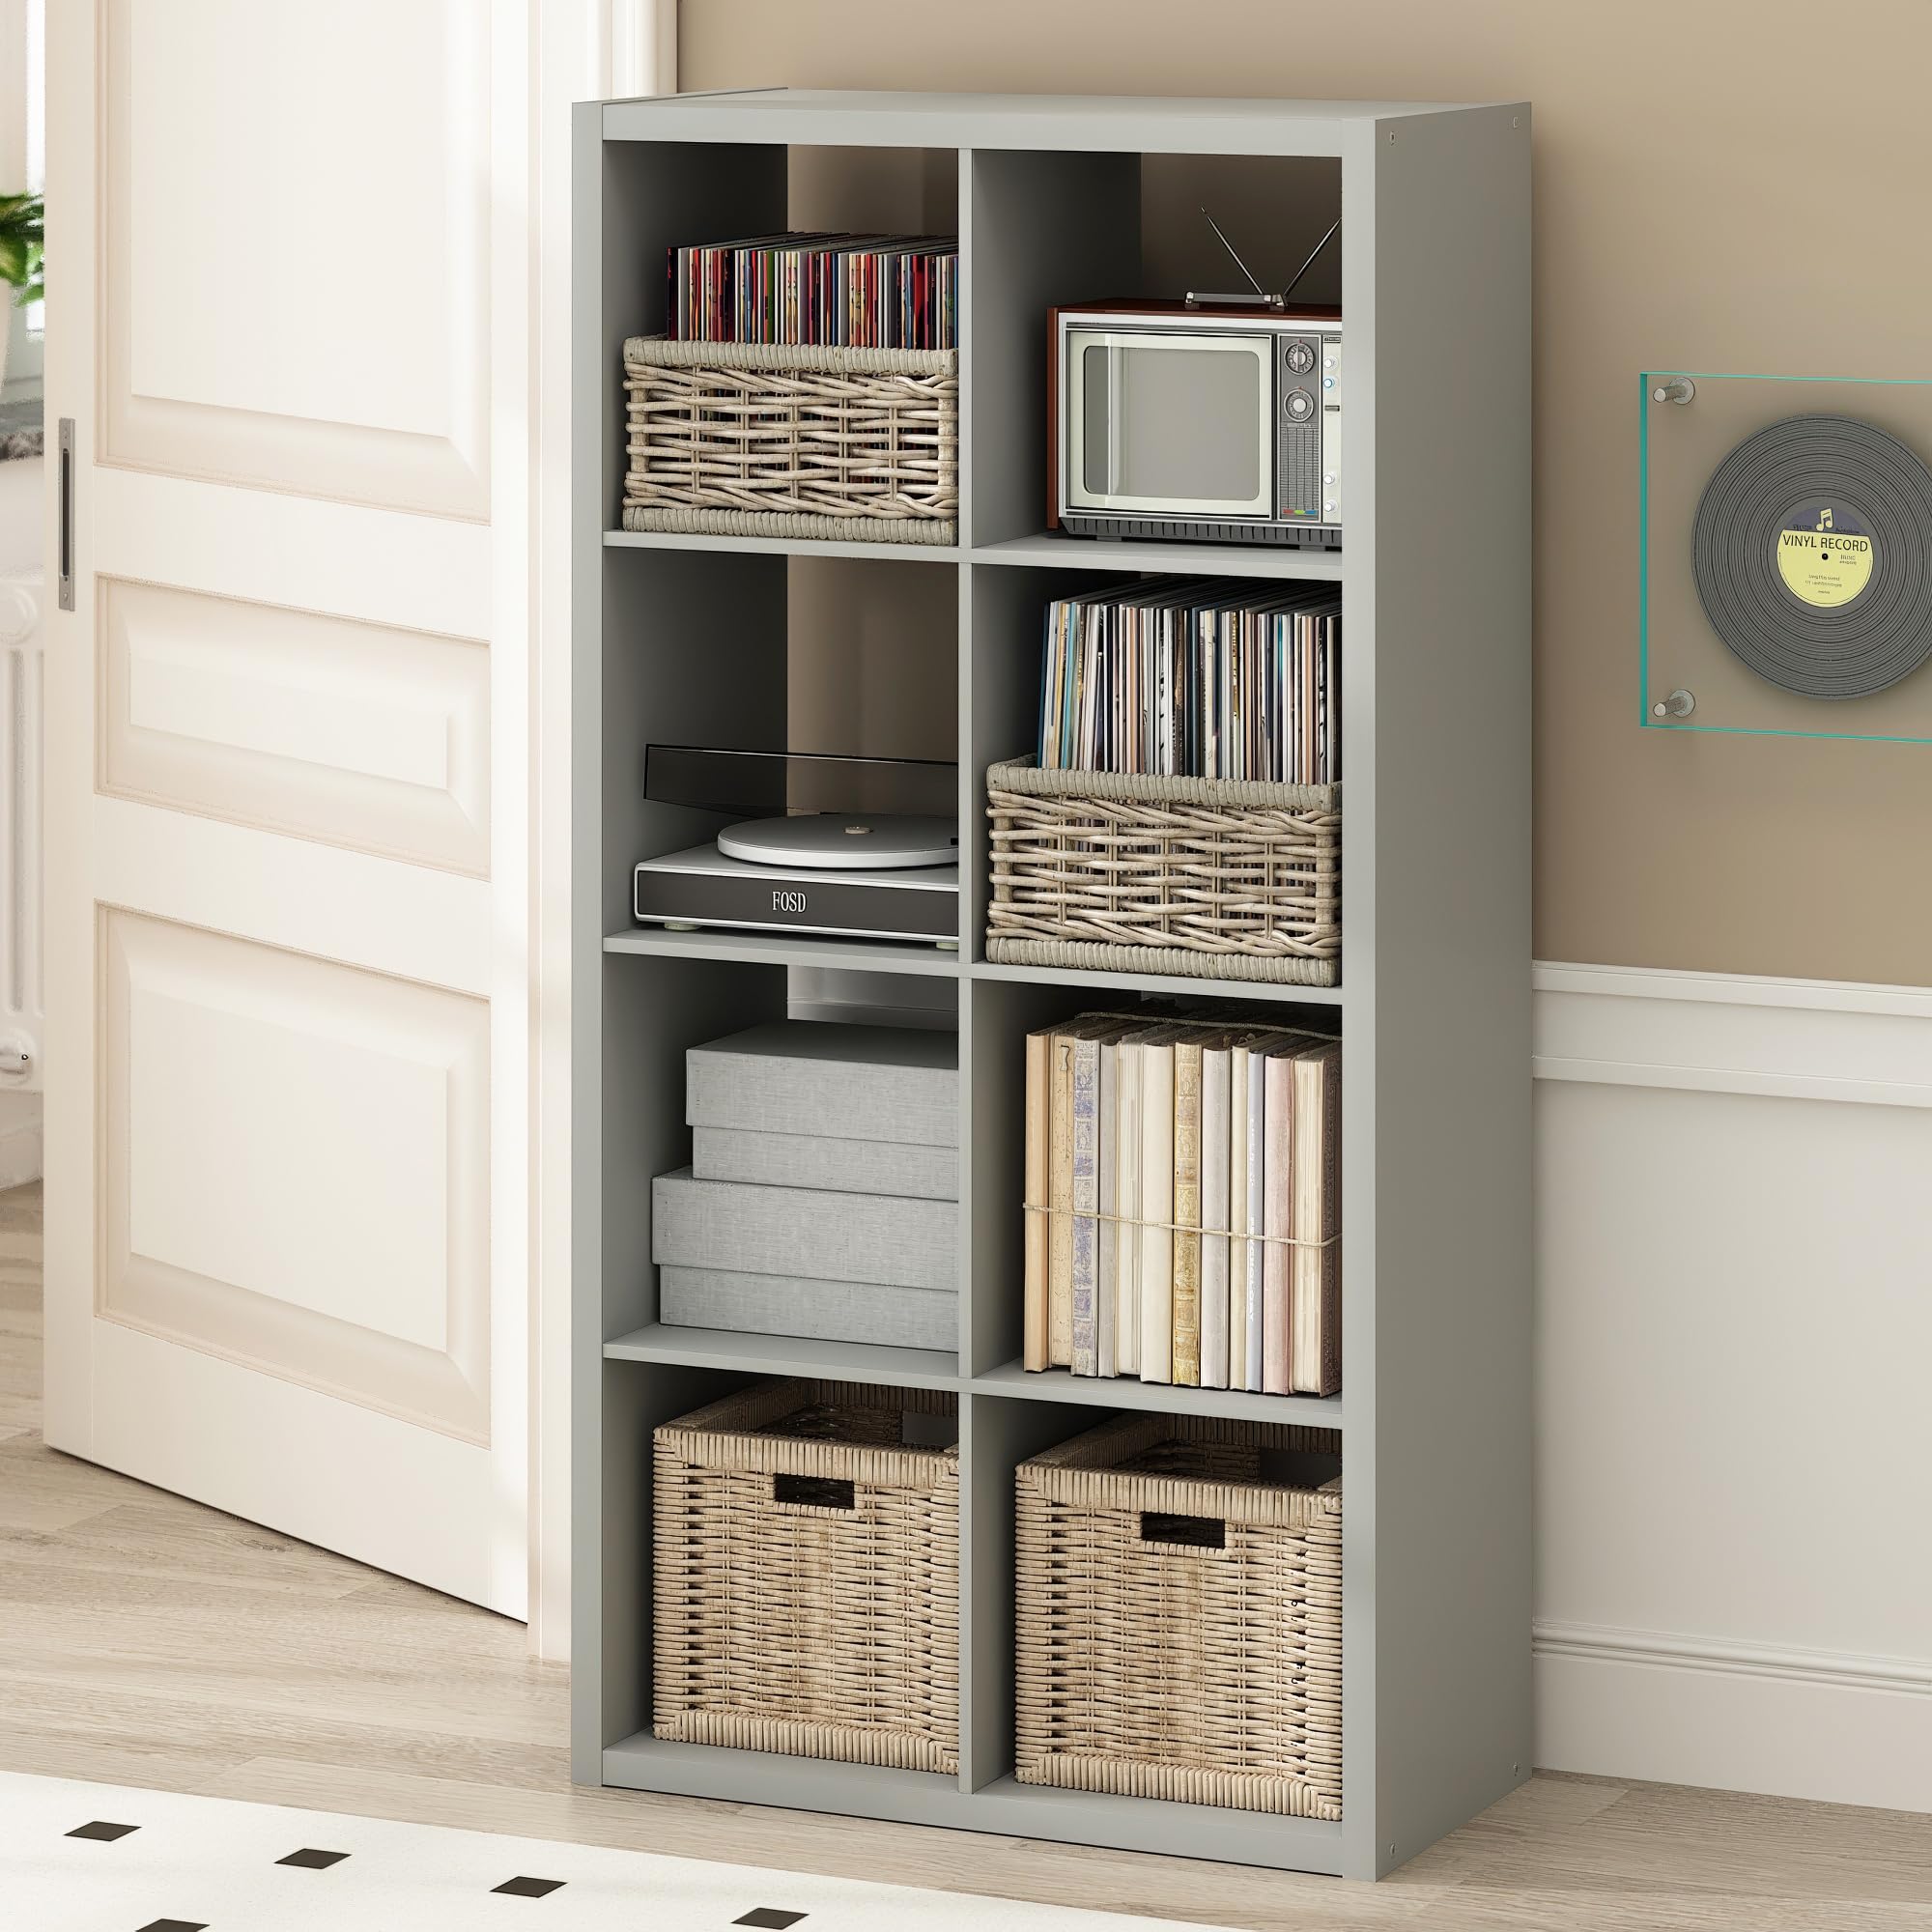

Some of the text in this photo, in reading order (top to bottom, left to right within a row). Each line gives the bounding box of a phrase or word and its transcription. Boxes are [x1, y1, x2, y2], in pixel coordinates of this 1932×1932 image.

[1782, 533, 1868, 553] VINYL RECORD
[772, 891, 807, 913] FOSD
